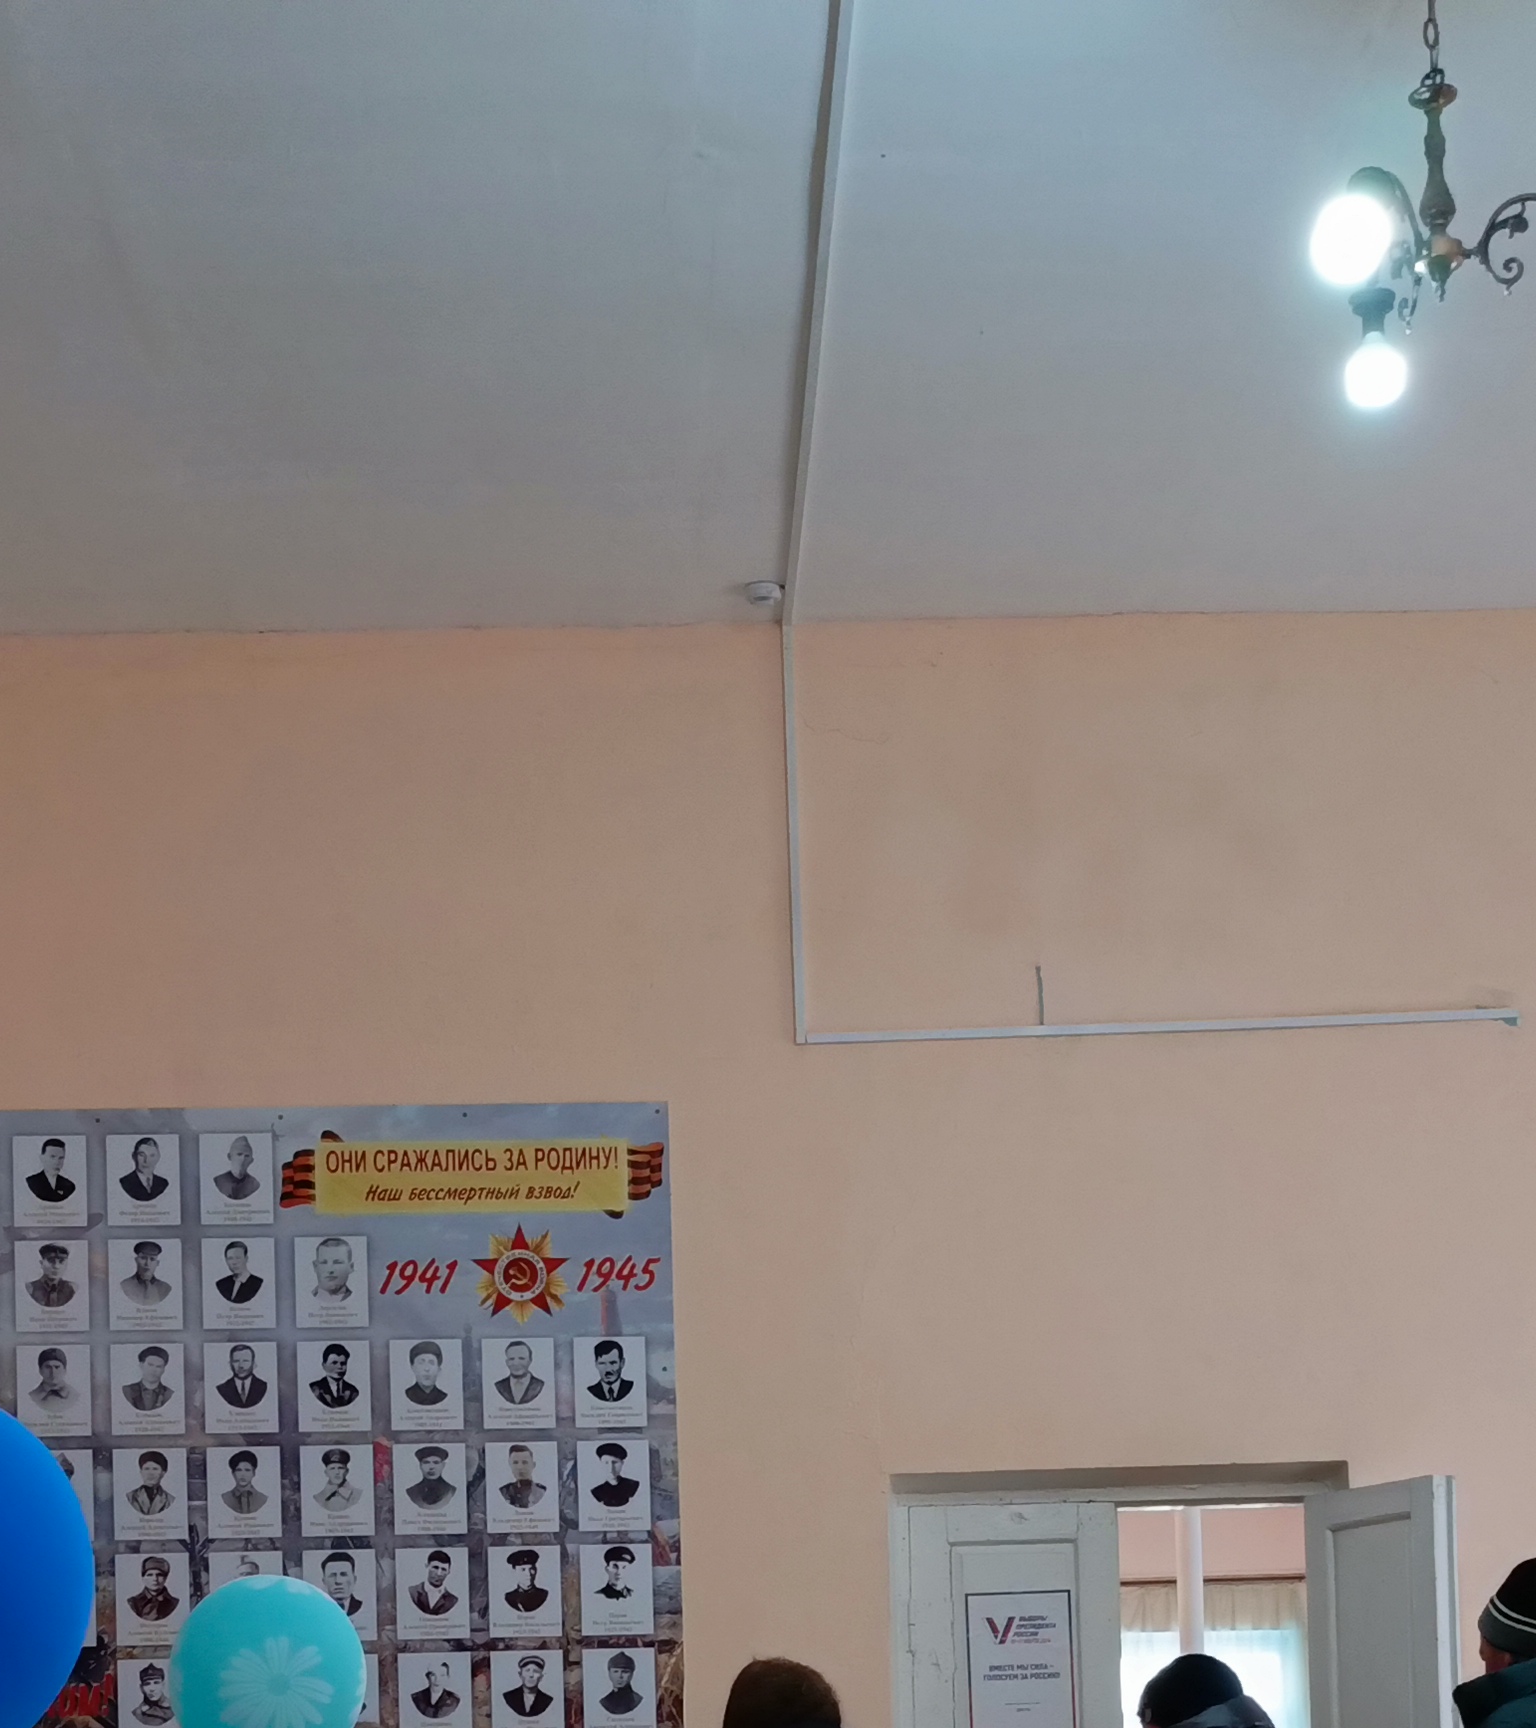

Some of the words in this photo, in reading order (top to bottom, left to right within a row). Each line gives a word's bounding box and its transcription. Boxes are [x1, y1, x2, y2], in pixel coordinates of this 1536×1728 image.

[326, 1149, 366, 1174] ОНИ
[373, 1148, 497, 1174] СРАЖАЛИСЬ
[503, 1147, 529, 1172] ЗА
[534, 1145, 619, 1175] РОДИНУ!
[365, 1184, 402, 1202] Наш
[409, 1183, 520, 1205] бессмертный
[526, 1181, 581, 1200] взвод!
[379, 1257, 459, 1296] 1941
[576, 1256, 662, 1293] 1945
